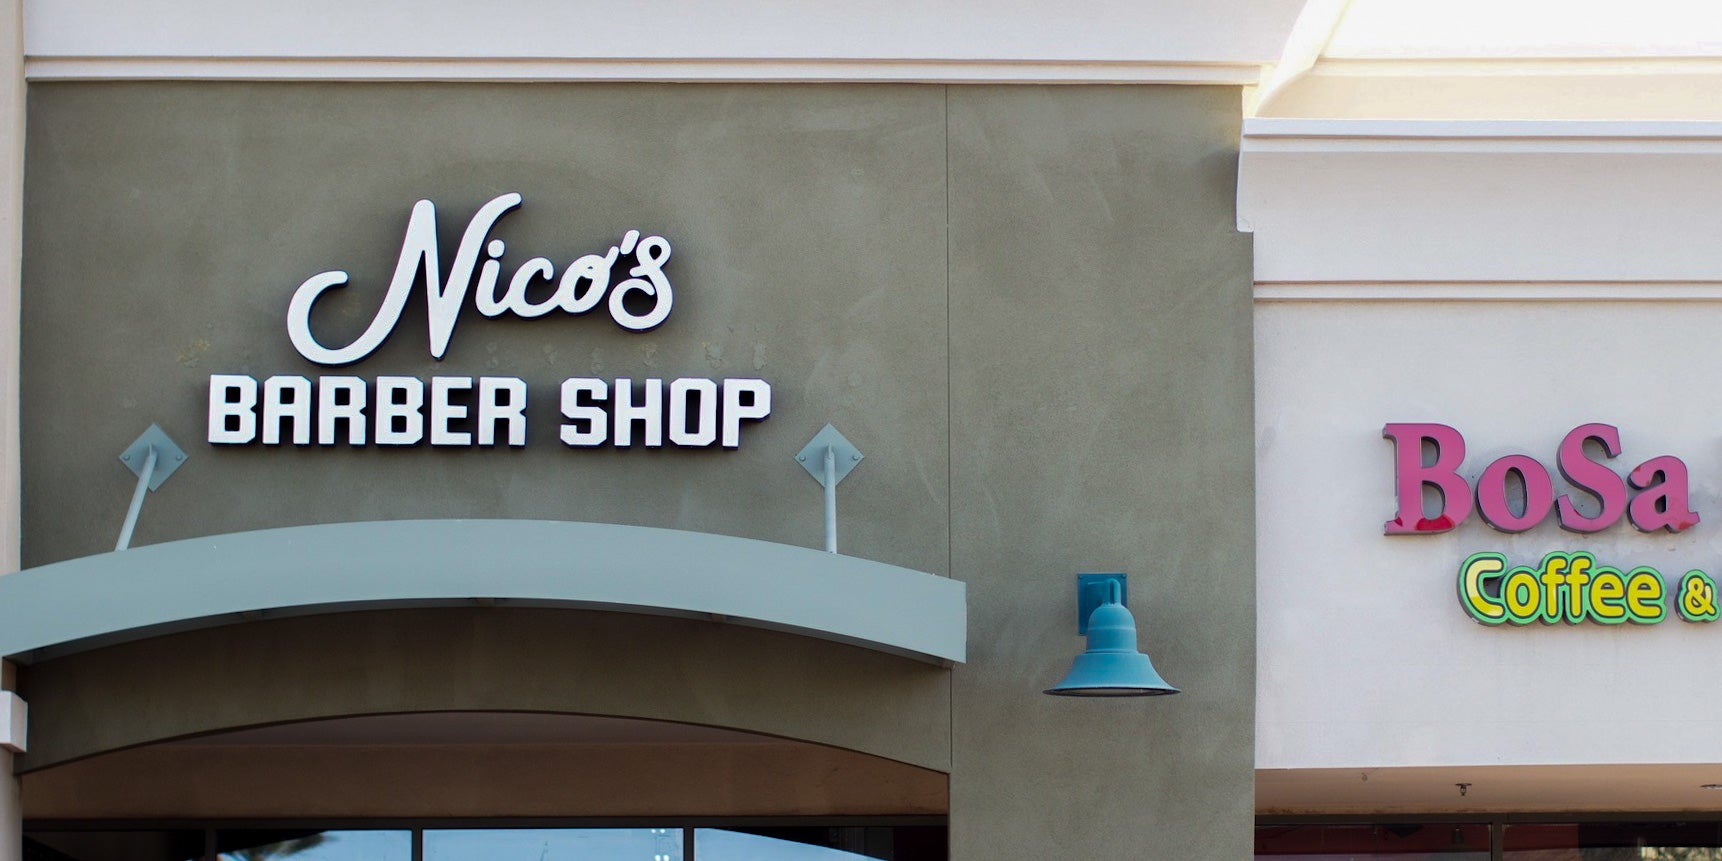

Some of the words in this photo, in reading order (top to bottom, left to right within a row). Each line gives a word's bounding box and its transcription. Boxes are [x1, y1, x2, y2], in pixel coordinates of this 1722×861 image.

[287, 192, 673, 365] Nico's
[208, 374, 527, 446] BARBER
[560, 377, 771, 448] SHOP
[1383, 422, 1700, 535] BoSa
[1459, 553, 1666, 623] Coffee
[1679, 571, 1720, 621] &
